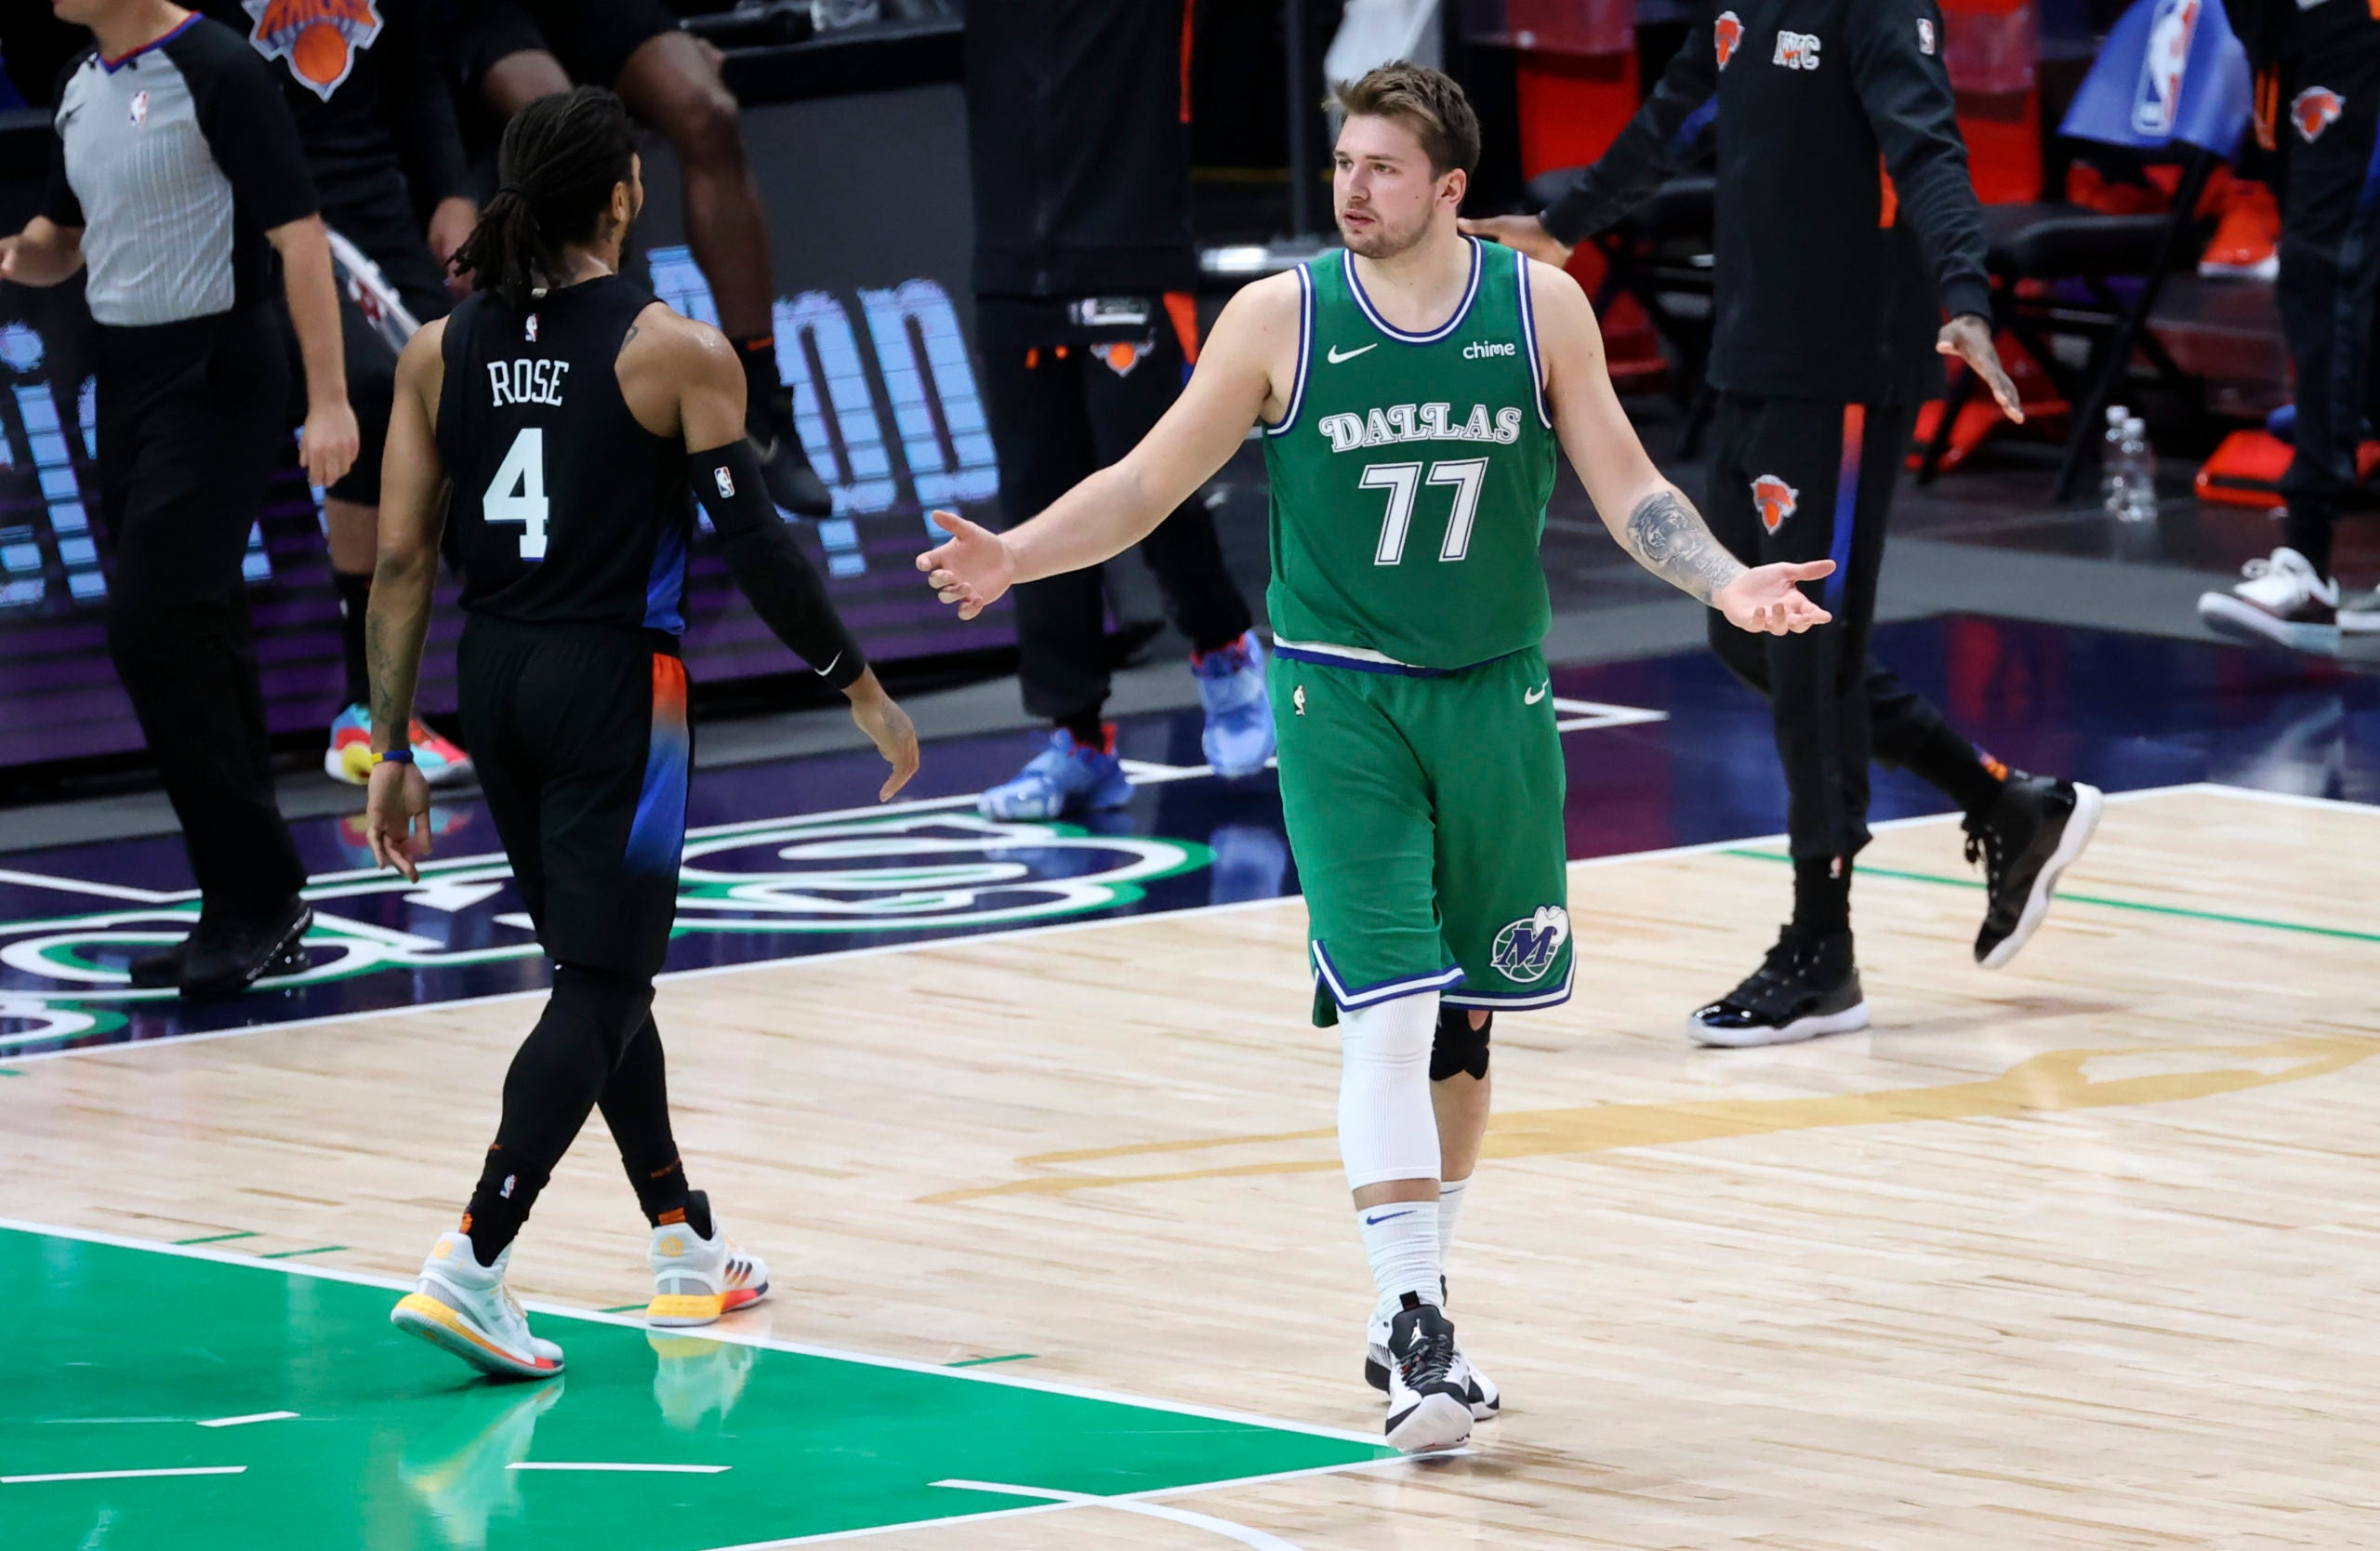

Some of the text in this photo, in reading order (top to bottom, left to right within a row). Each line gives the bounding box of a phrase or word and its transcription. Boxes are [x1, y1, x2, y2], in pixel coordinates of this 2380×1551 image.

[1462, 339, 1515, 360] chime
[486, 358, 570, 407] ROSE
[1318, 402, 1523, 453] DALLAS
[482, 427, 549, 562] 4
[1357, 457, 1489, 565] 77
[1490, 925, 1558, 968] M
